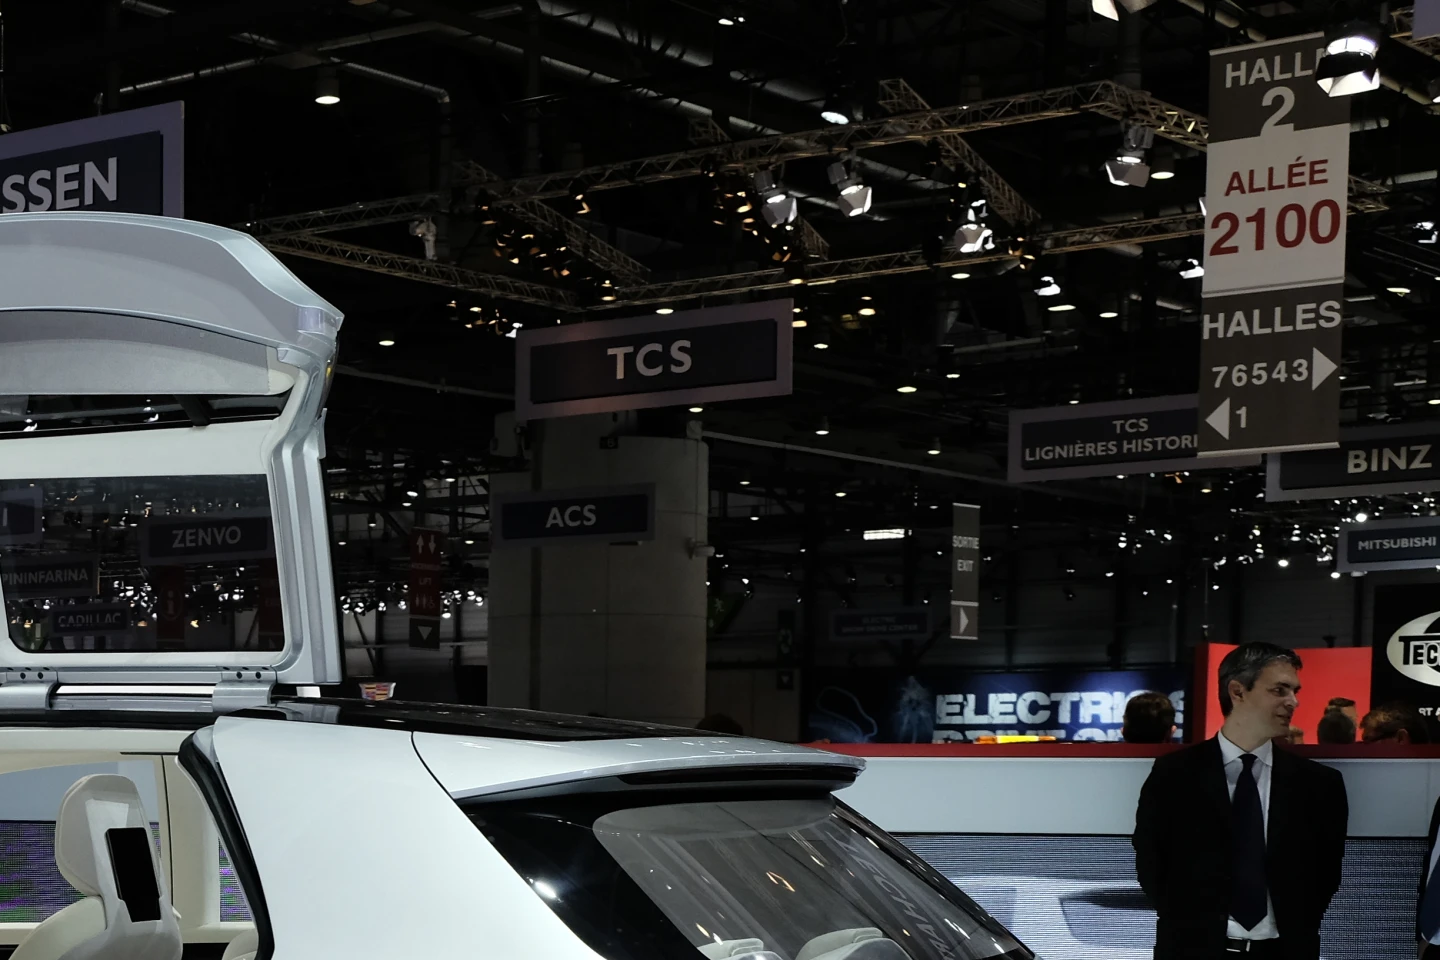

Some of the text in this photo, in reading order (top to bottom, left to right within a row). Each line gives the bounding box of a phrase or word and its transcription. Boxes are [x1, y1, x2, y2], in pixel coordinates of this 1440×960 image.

[1259, 86, 1295, 137] 2
[1224, 155, 1328, 197] ALLÉE
[1209, 199, 1341, 257] 2100
[1202, 300, 1342, 340] HALLES
[607, 339, 693, 380] TCS
[1212, 358, 1309, 389] 76543
[1112, 418, 1149, 434] TCS
[1235, 406, 1248, 429] 1
[1025, 434, 1198, 462] LIGNIÈRES HISTORI
[1347, 444, 1433, 474] BINZ
[545, 504, 597, 528] ACS
[172, 526, 242, 549] ZENVO
[952, 535, 980, 550] SORTIE
[1358, 536, 1437, 551] MITSUBISHI
[2, 567, 89, 586] PININFARINA
[957, 559, 974, 572] EXIT
[58, 612, 122, 628] CADILLAC
[935, 690, 1154, 725] ELECTRI
